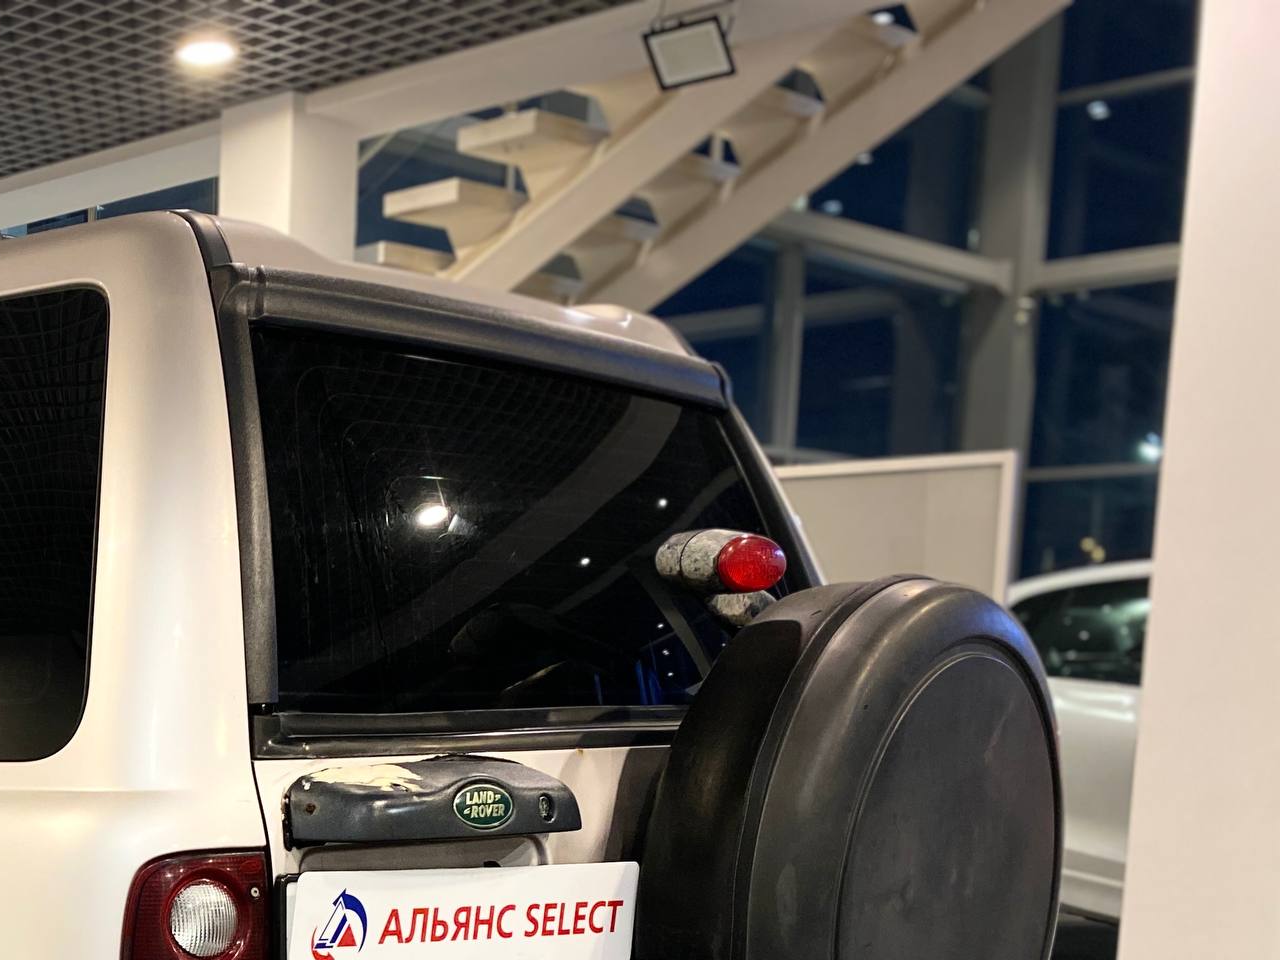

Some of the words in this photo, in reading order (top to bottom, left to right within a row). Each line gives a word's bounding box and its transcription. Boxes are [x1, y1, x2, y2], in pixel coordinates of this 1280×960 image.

[465, 790, 495, 805] LAND
[470, 803, 505, 819] ROVER
[378, 904, 517, 945] АЛЬЯНС
[524, 899, 624, 937] SELECT
